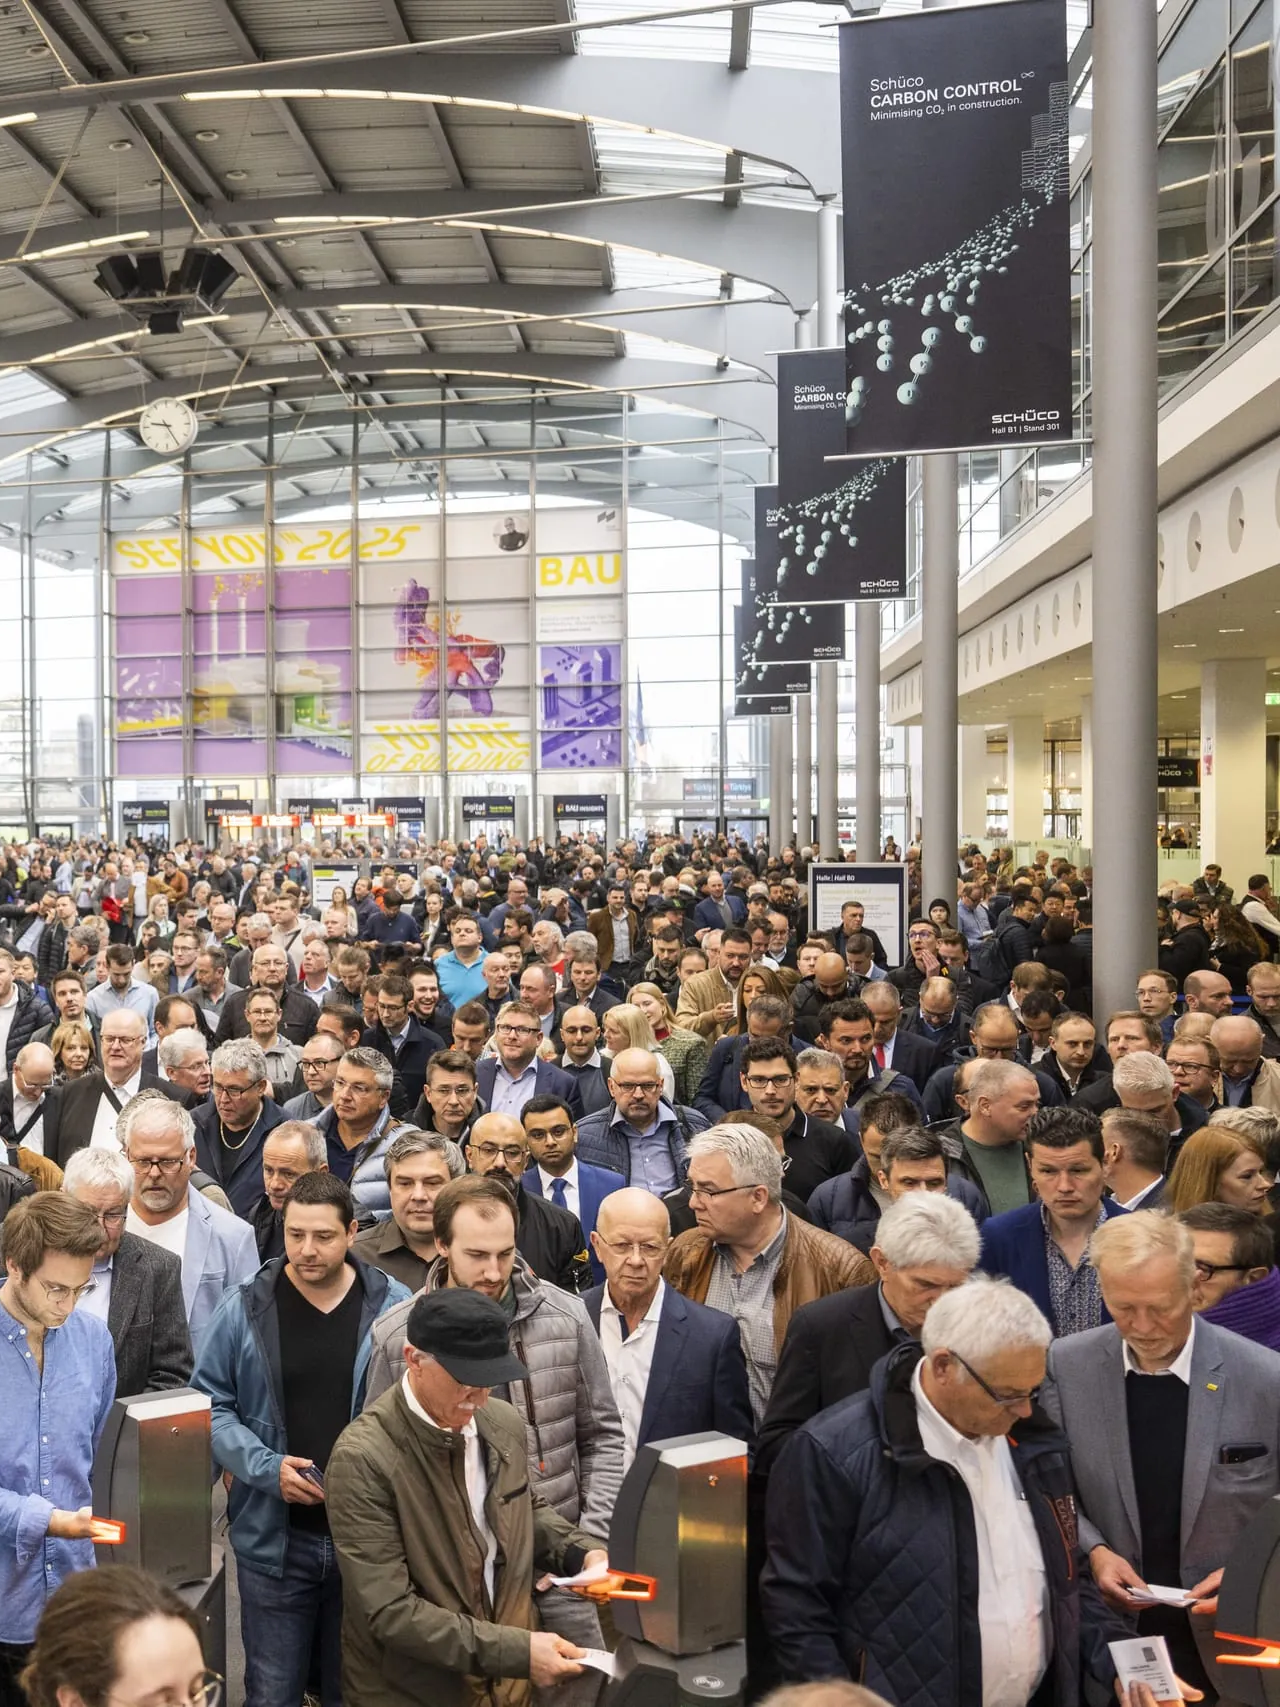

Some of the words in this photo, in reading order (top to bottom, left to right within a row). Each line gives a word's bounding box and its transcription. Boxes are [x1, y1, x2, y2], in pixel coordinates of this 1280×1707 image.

[870, 76, 924, 92] Schüco
[871, 88, 938, 108] CARBON
[943, 79, 1022, 99] CONTROL
[871, 107, 923, 120] Minimising
[947, 103, 957, 112] in
[959, 96, 1023, 110] construction.
[794, 392, 834, 403] CARBON
[991, 409, 1060, 424] SCHÜCO
[1024, 424, 1045, 432] Stand
[1046, 423, 1060, 431] 301
[192, 533, 285, 564] YOU
[297, 525, 421, 560] 2025
[540, 553, 622, 586] BAU
[860, 579, 899, 588] SCHÜCO
[366, 753, 406, 773] OF
[464, 803, 486, 813] digital
